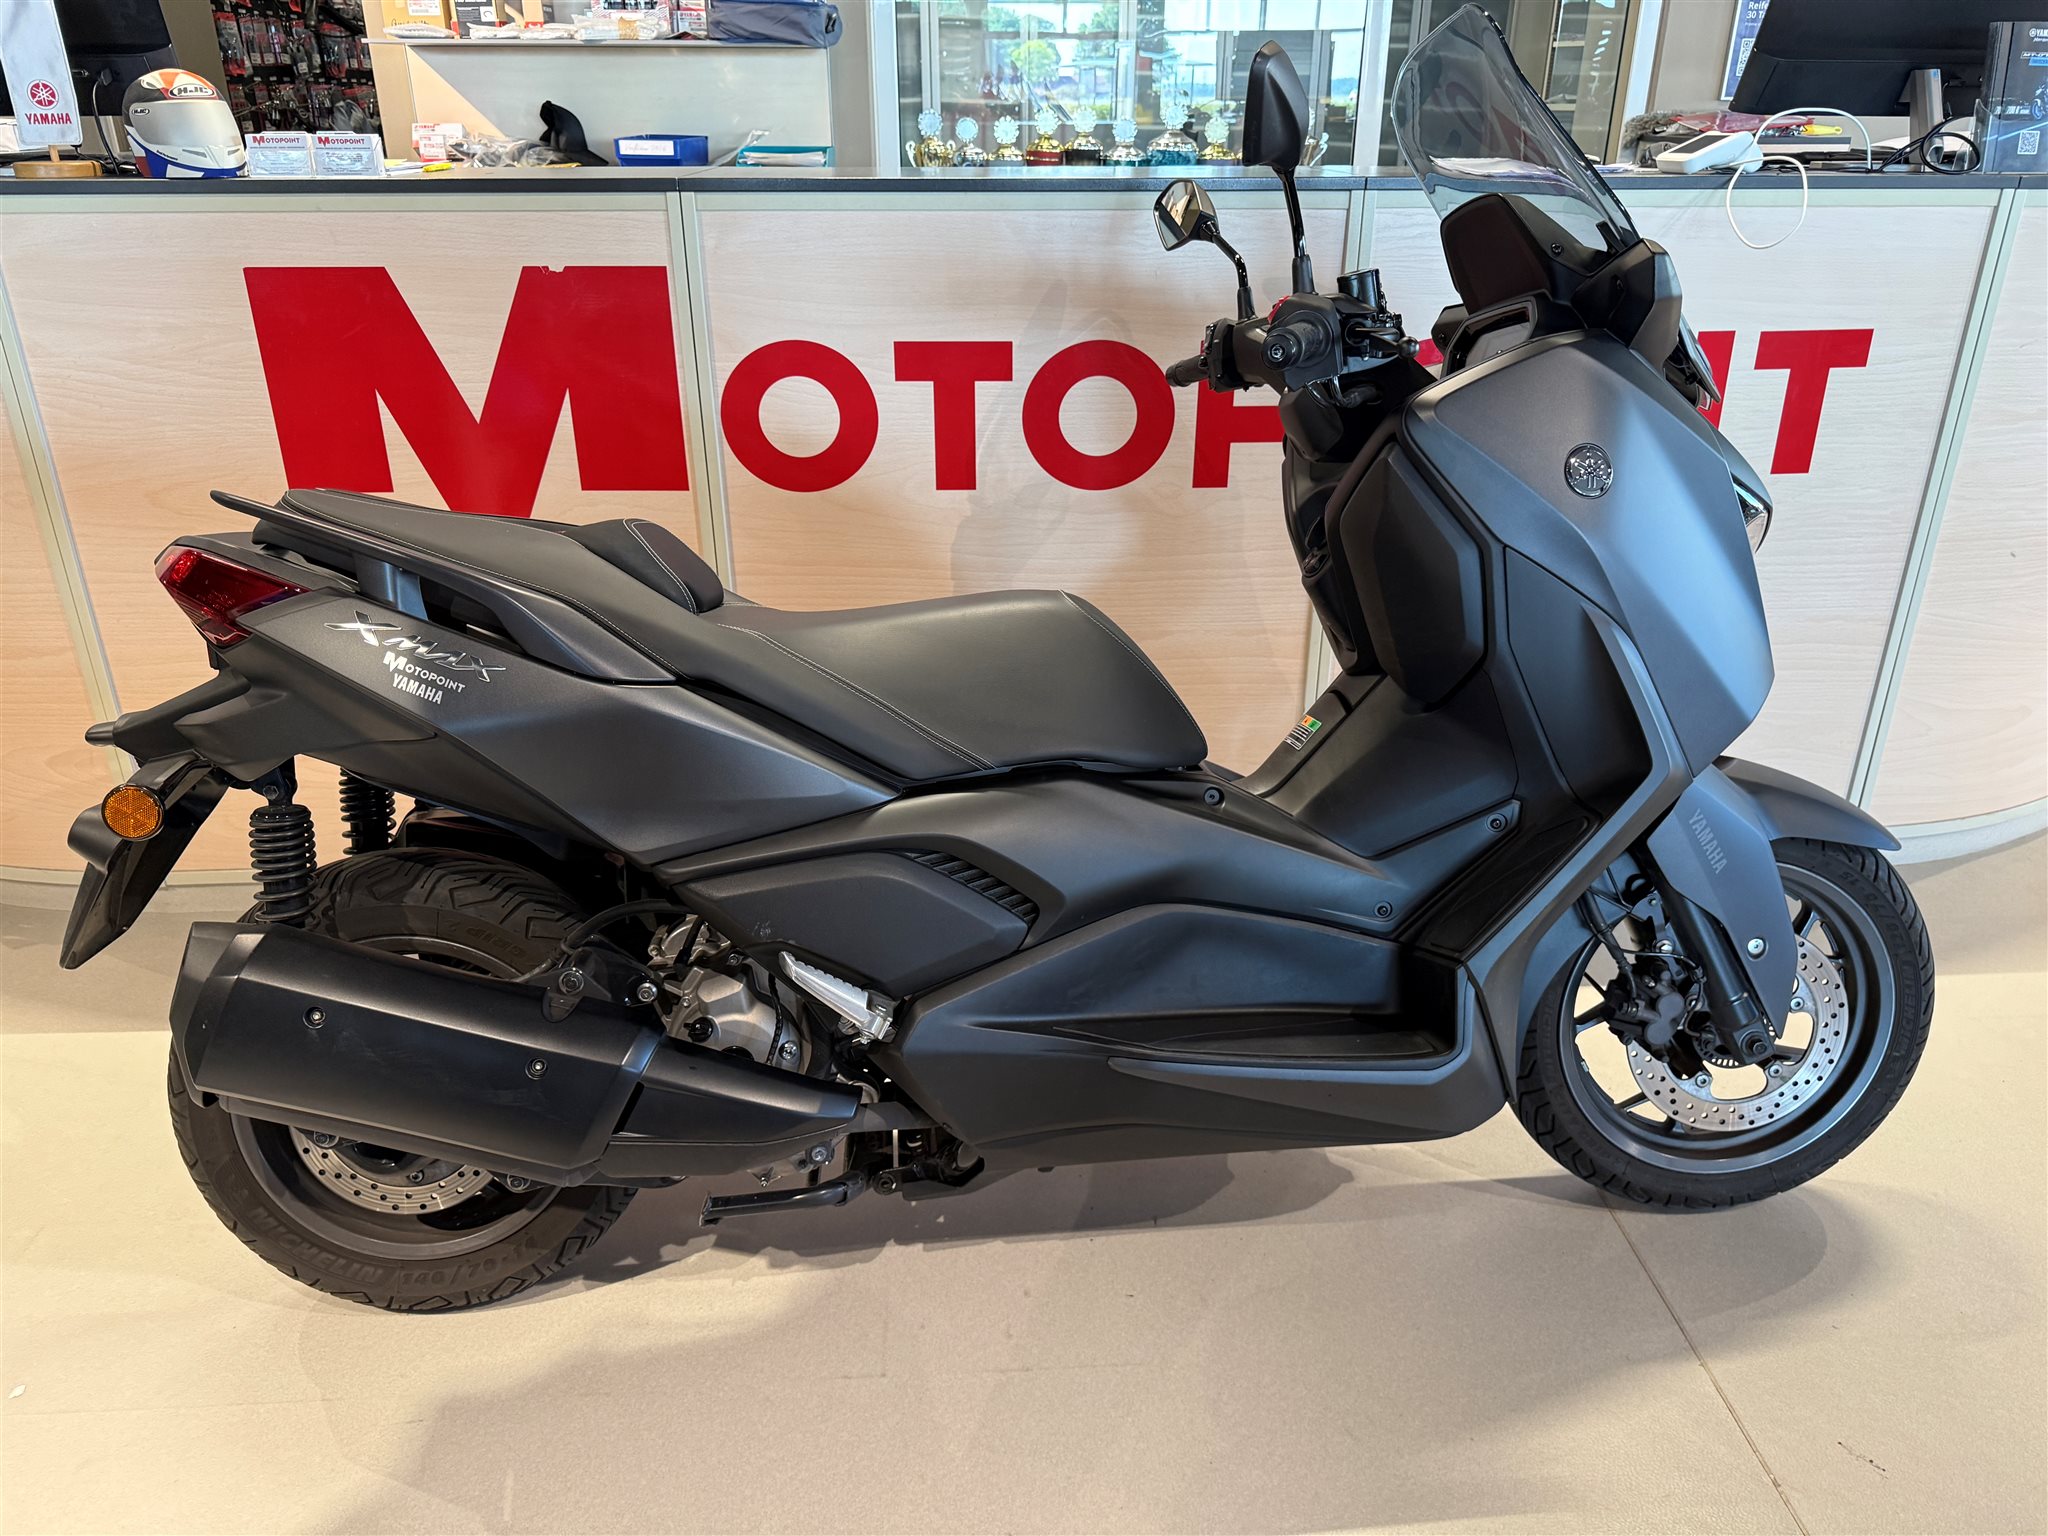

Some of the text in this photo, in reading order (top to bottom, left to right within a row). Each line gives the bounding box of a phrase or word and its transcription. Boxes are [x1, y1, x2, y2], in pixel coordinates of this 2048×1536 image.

[1746, 10, 1757, 19] 30
[177, 86, 209, 95] HJC
[25, 113, 72, 125] YAMAHA
[252, 136, 300, 146] MOTOPOINT
[317, 136, 365, 147] MOTOPOINT
[243, 266, 1874, 518] MOTOT
[383, 651, 466, 693] MOTOPOINT
[392, 673, 444, 705] YAMAHA
[1689, 808, 1728, 875] YAMAHA
[249, 1206, 384, 1283] MICHELIN
